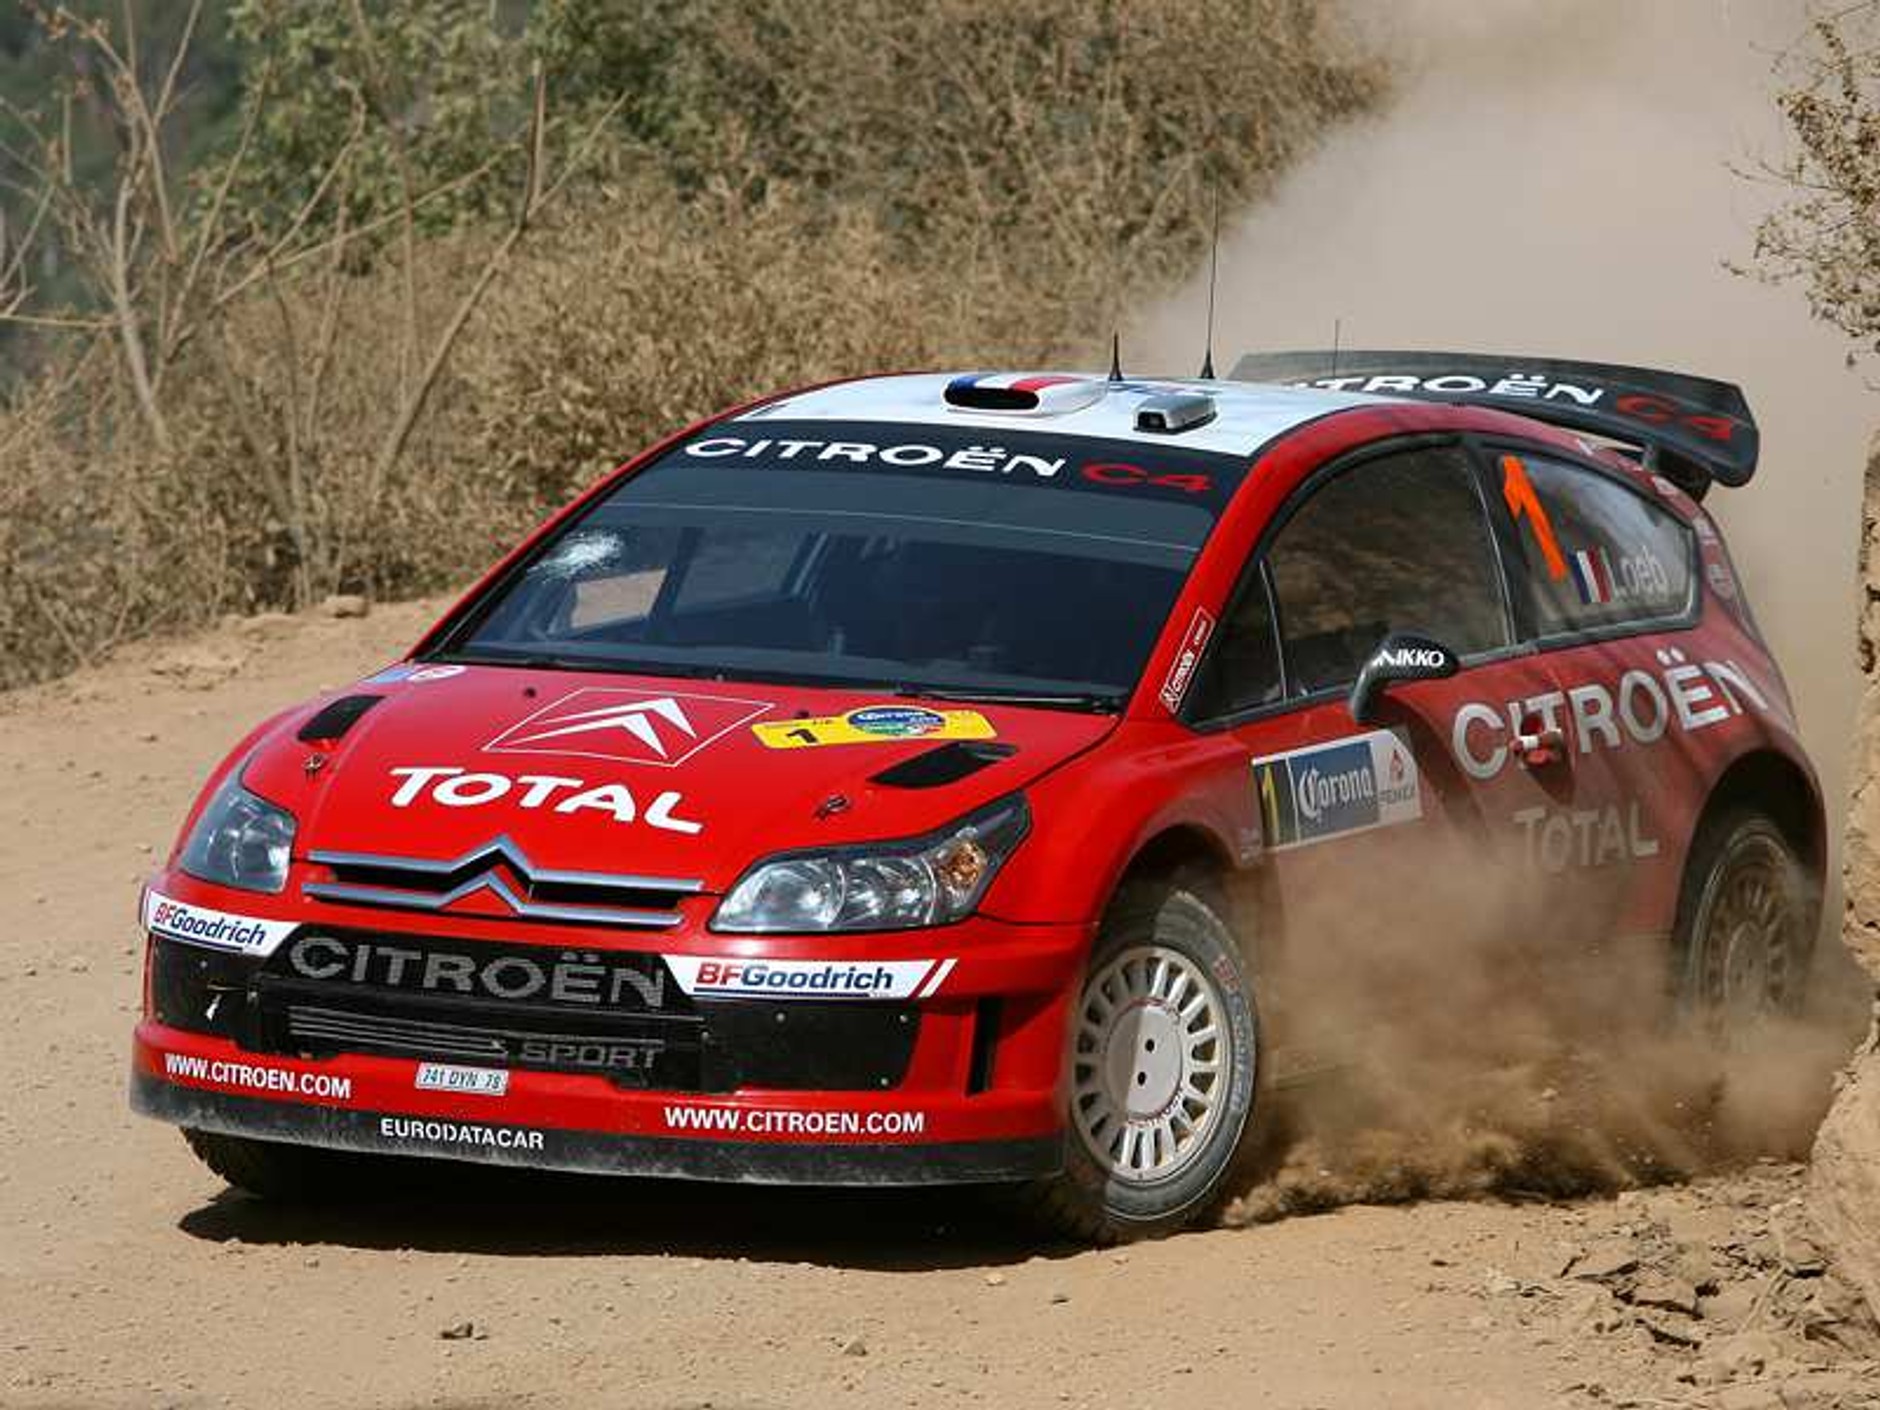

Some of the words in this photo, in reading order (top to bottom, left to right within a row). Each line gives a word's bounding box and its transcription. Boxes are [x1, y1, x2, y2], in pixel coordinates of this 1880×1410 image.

[1616, 392, 1736, 439] C4
[685, 437, 1066, 477] CITROËN
[1081, 461, 1212, 491] C4
[1503, 454, 1569, 582] 1
[1452, 647, 1768, 780] CITROËN
[390, 767, 702, 834] TOTAL
[1299, 763, 1374, 823] Corona
[1514, 803, 1659, 867] TOTAL
[153, 901, 266, 947] BFGoodrich
[290, 936, 665, 1008] CITROËN
[695, 961, 894, 991] BFGoodrich
[165, 1053, 351, 1099] WWW.CITROEN.COM
[520, 1041, 665, 1068] SPORT
[380, 1117, 545, 1150] EURODATACAR
[665, 1106, 924, 1134] WWW.CITROEN.COM
